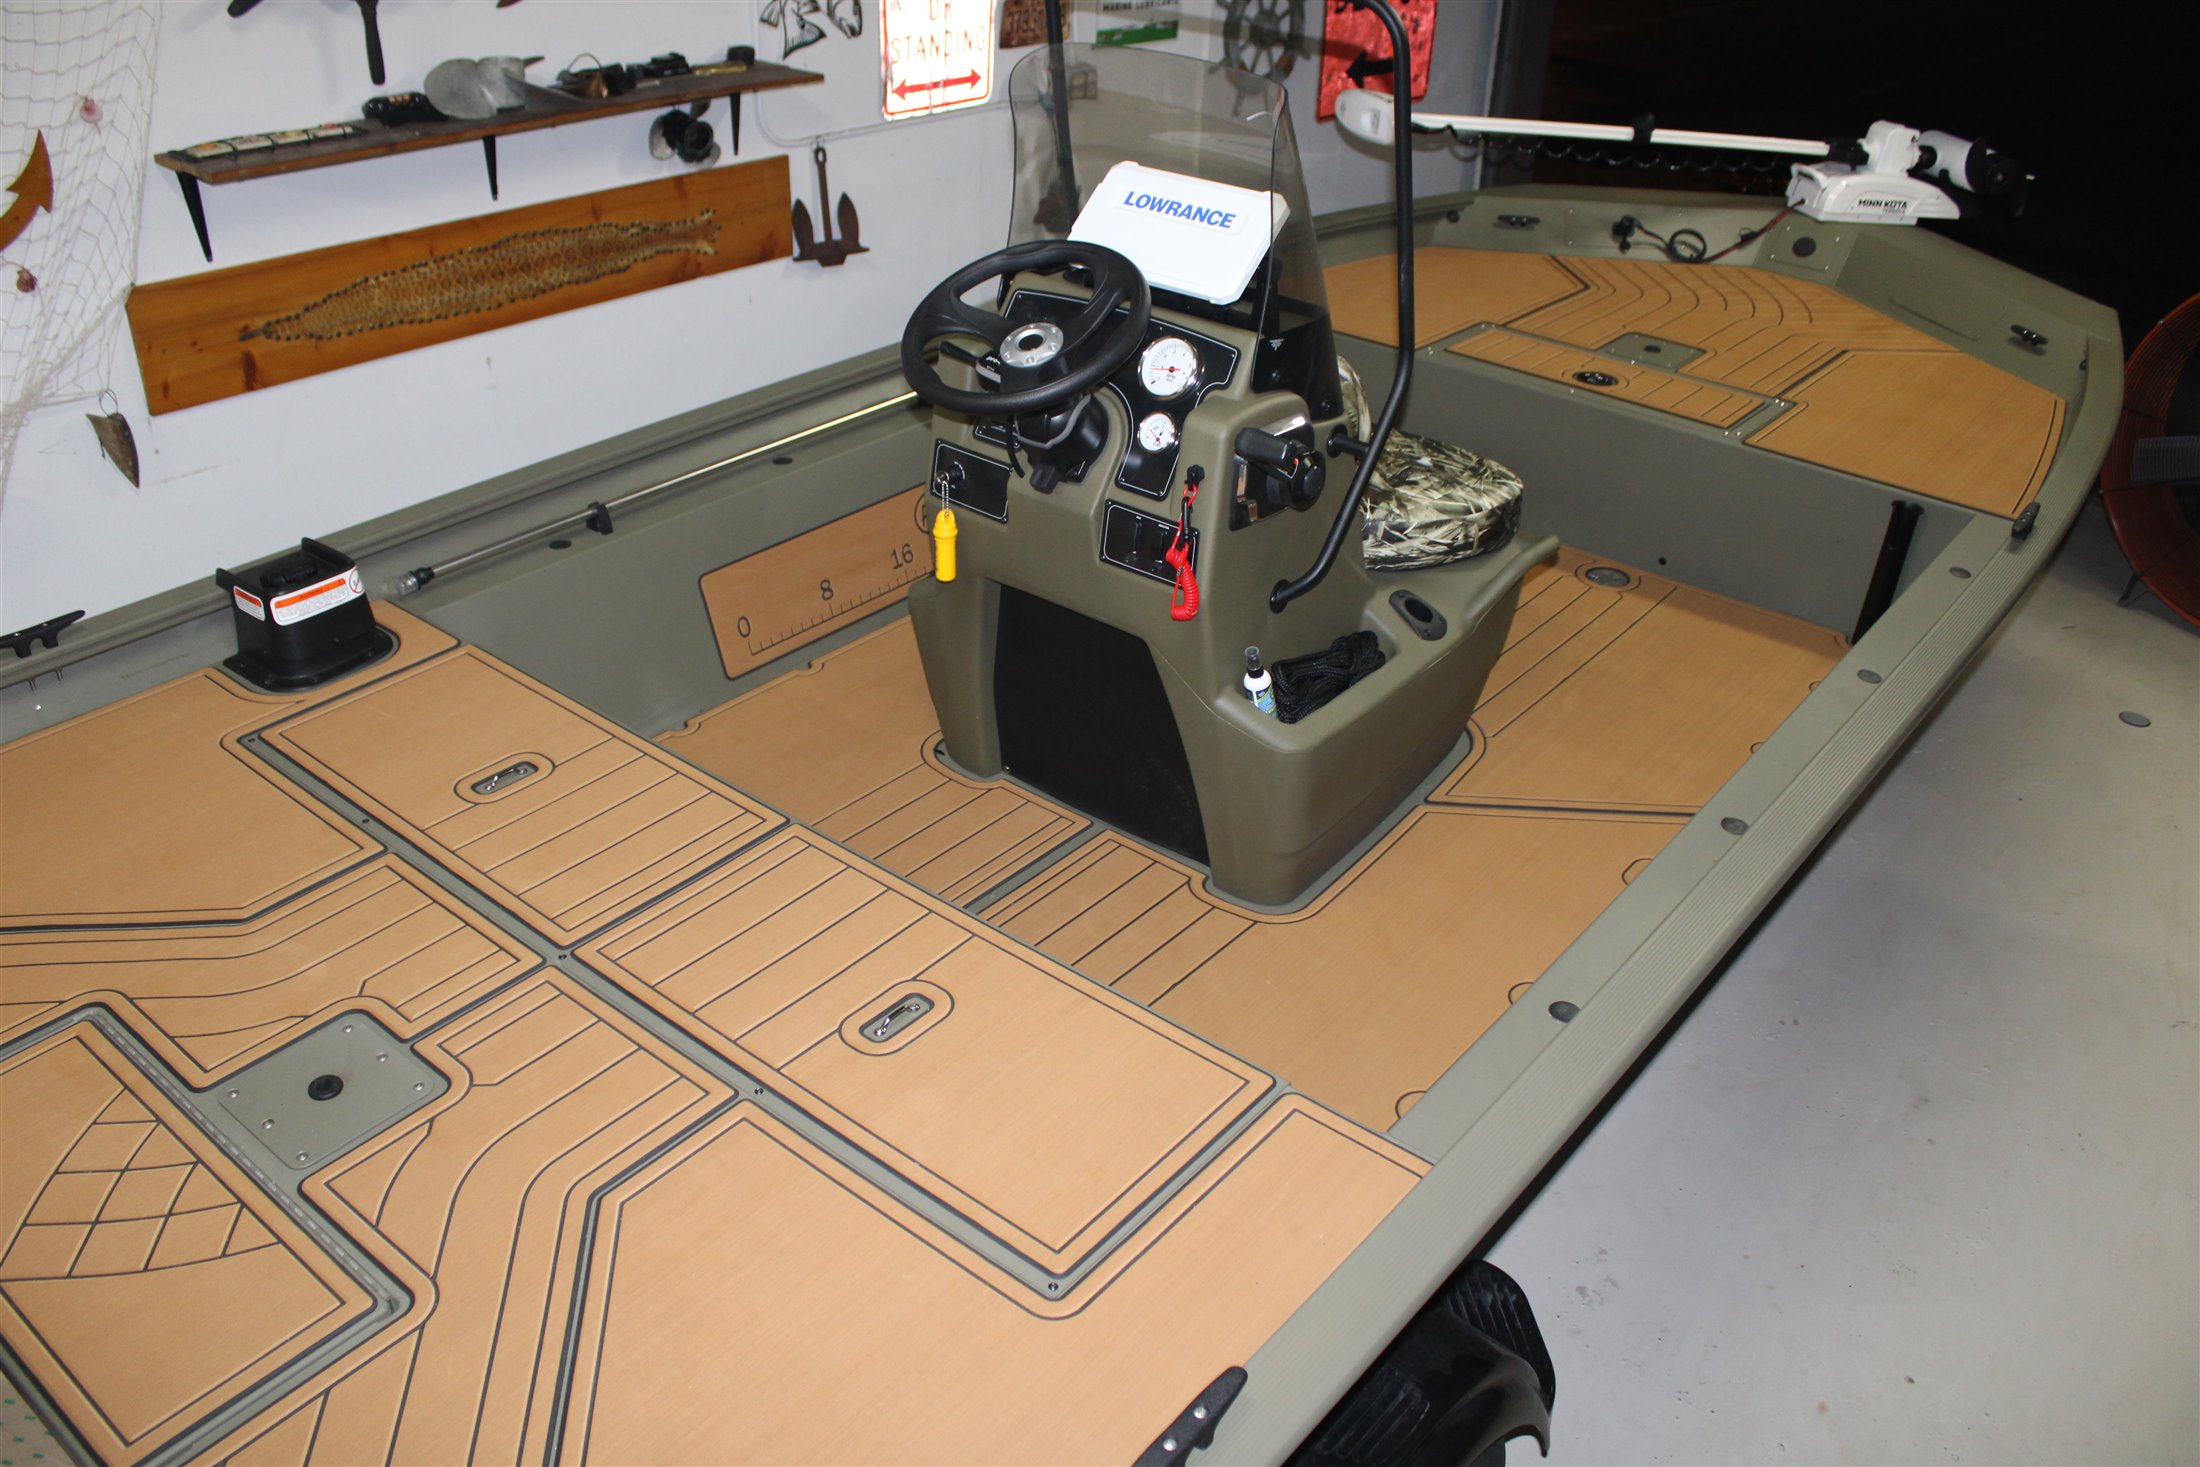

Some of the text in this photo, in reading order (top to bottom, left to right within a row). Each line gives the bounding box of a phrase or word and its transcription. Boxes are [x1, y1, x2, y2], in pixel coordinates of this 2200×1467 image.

[891, 26, 985, 64] STANDING
[1123, 190, 1236, 229] LOWRANCE
[1858, 199, 1907, 209] MINN KOTA
[737, 543, 914, 638] 0 8 16
